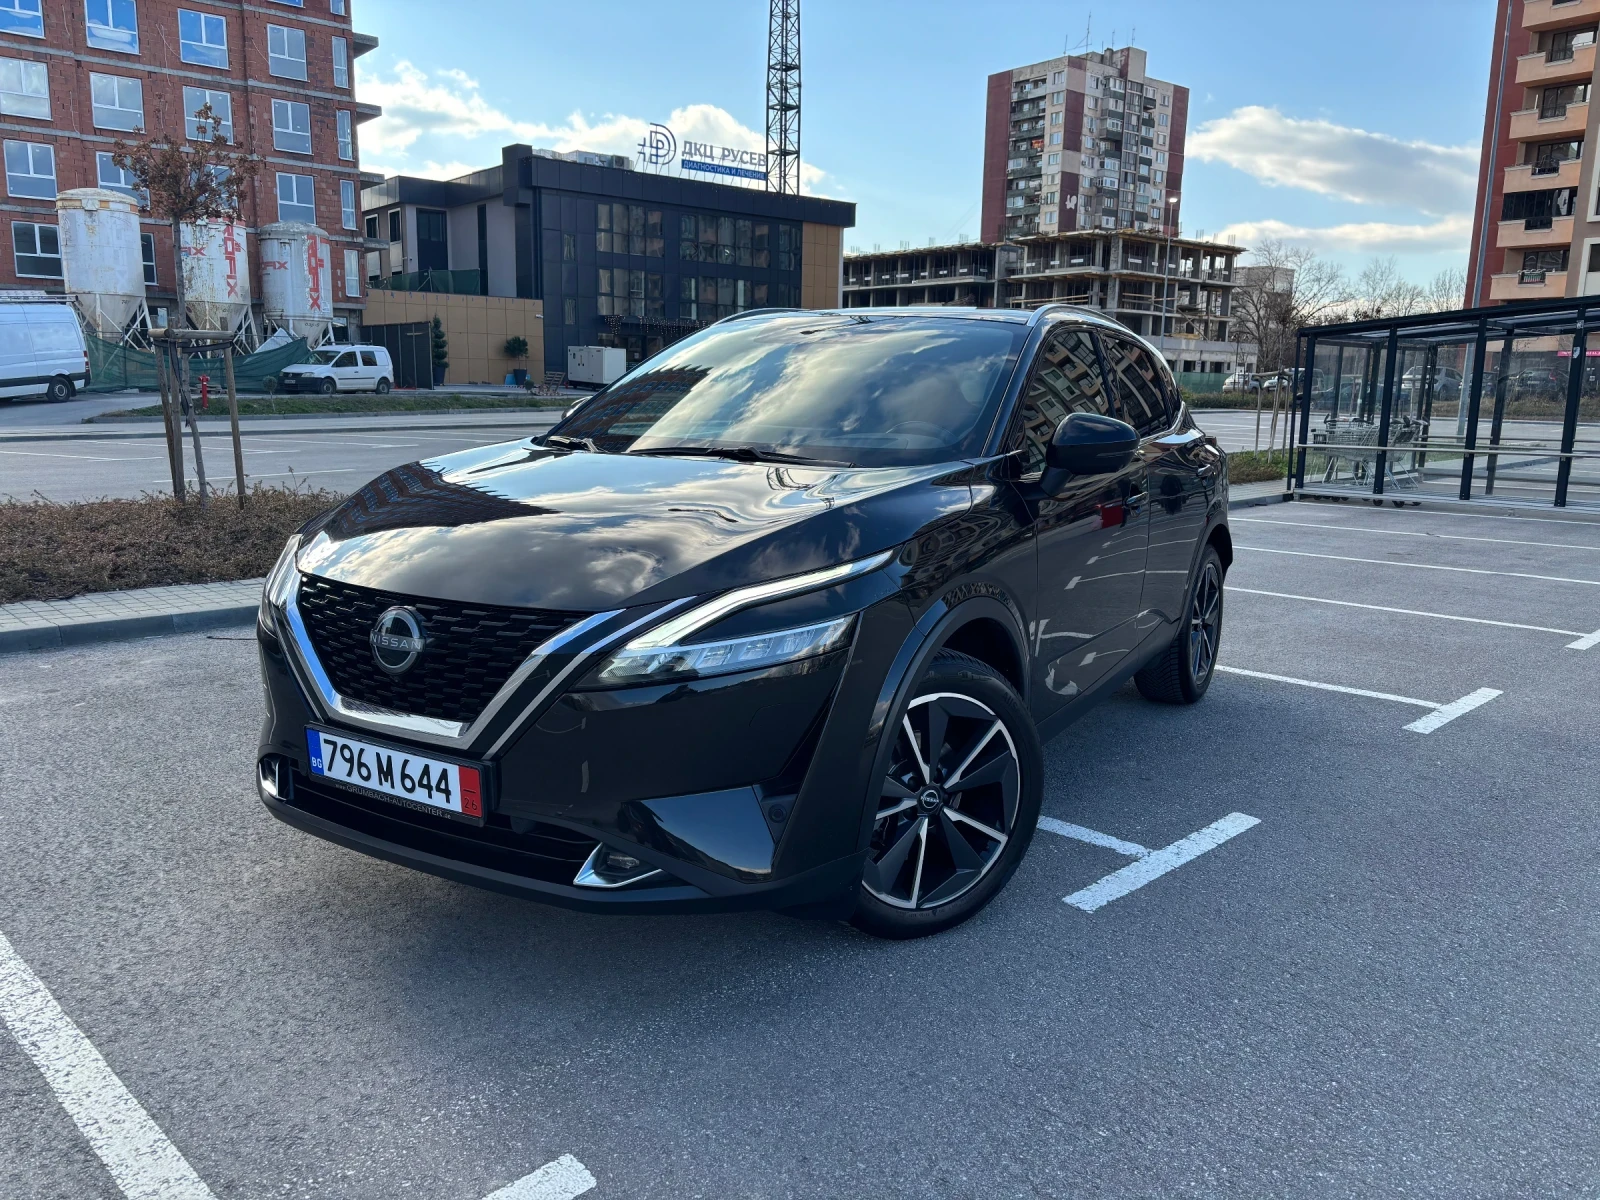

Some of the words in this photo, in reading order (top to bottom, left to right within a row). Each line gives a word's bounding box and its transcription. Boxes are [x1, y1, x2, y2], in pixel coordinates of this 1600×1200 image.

[682, 140, 715, 161] ДКЦ
[721, 147, 767, 167] РУСЕВ
[683, 161, 730, 174] ДИАГНОСТИКА
[737, 169, 765, 180] ЛЕЧЕНИЕ
[370, 633, 422, 650] NISSAN
[311, 756, 323, 769] BG
[464, 797, 478, 811] 26
